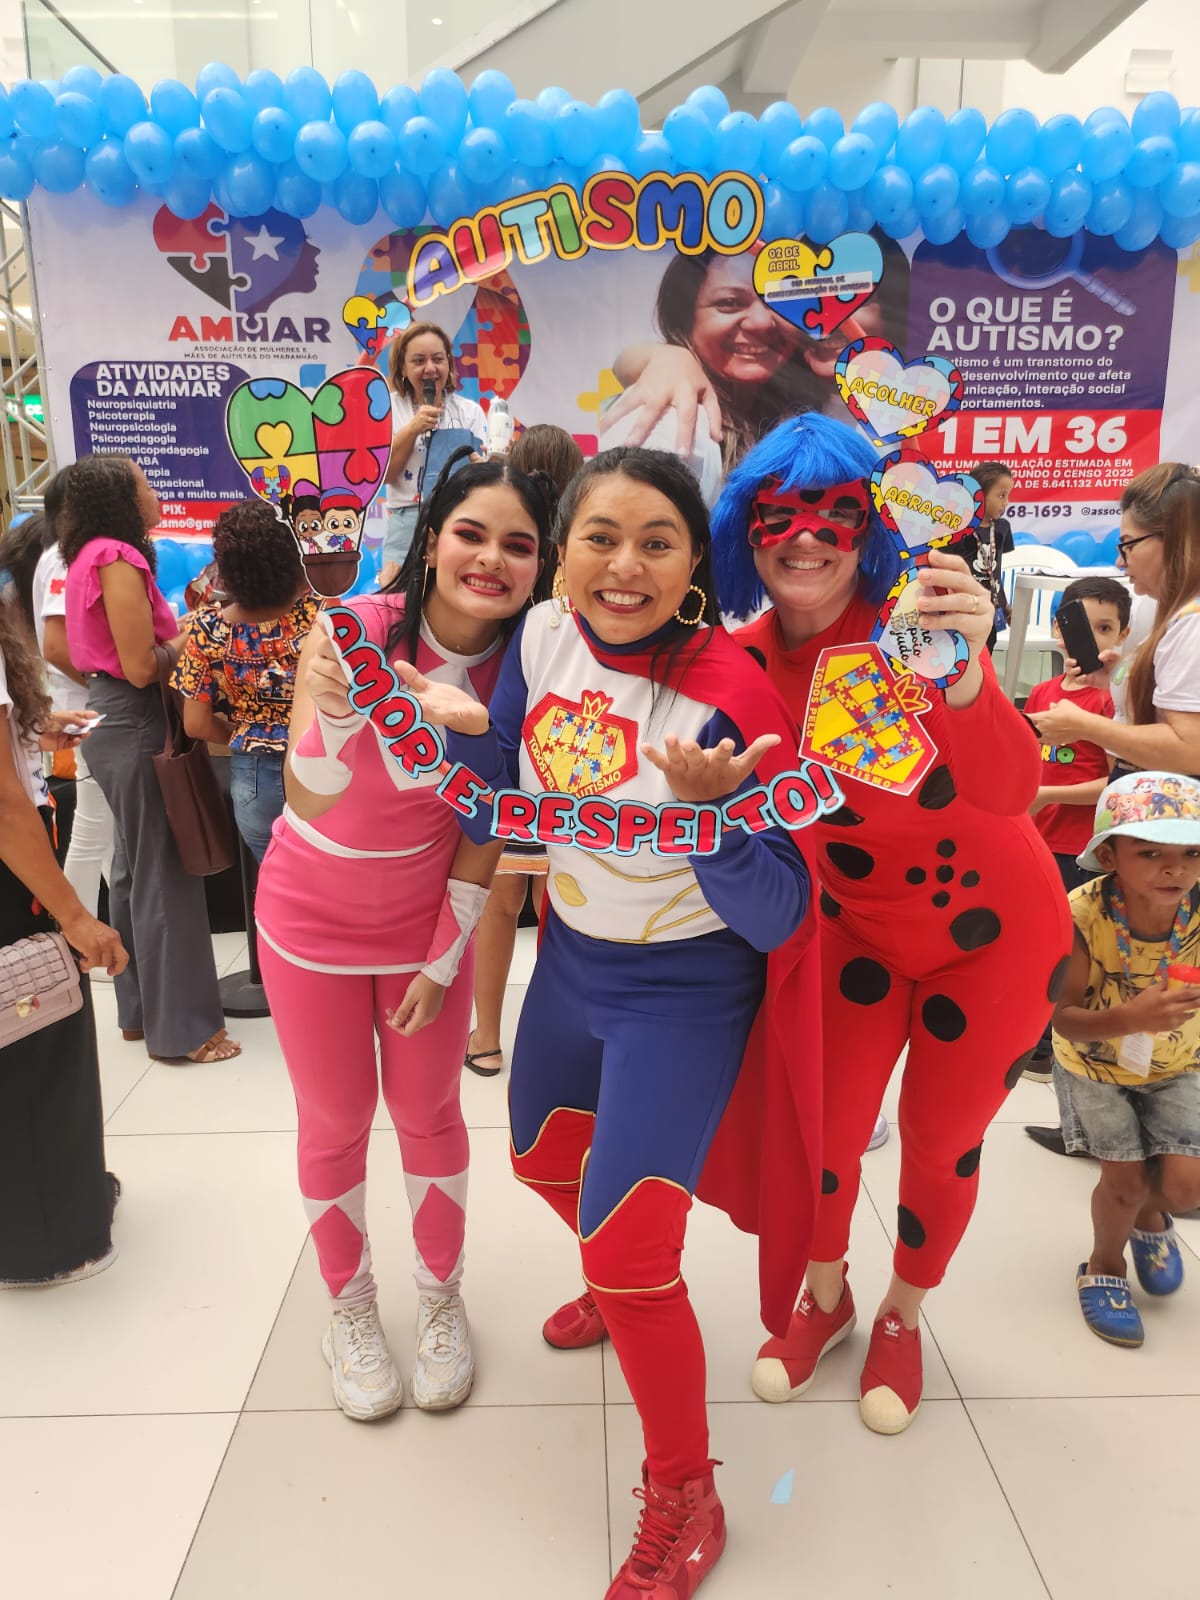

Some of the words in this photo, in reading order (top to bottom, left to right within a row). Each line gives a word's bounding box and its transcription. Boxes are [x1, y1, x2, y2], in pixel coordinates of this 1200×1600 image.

[408, 173, 762, 305] AUTISMO
[768, 247, 782, 258] 02
[784, 246, 799, 257] DE
[768, 260, 800, 272] ABRIL
[929, 297, 956, 323] O
[966, 297, 1043, 325] QUE
[1052, 289, 1073, 323] É
[168, 316, 331, 343] AMMAR
[927, 325, 1124, 351] AUTISMO?
[194, 345, 245, 353] ASSOCIAÇÃO
[951, 357, 989, 367] tismo
[993, 356, 1001, 367] é
[1004, 358, 1023, 367] um
[1027, 356, 1093, 367] transtorno
[1097, 356, 1113, 367] do
[96, 363, 230, 381] ATIVIDADES
[1071, 371, 1095, 382] que
[1098, 369, 1131, 380] afeta
[97, 381, 129, 396] DA
[134, 381, 222, 397] AMMAR
[1025, 383, 1085, 396] interação
[1087, 383, 1126, 394] social
[850, 377, 937, 418] ACOLHER
[87, 400, 177, 410] Neuropsiquiatria
[960, 399, 1045, 410] portamentos.
[88, 411, 155, 422] Psicoterapia
[89, 422, 177, 433] Neuropsicologia
[91, 434, 177, 445] Psicopedagogia
[938, 417, 958, 454] 1
[972, 416, 1053, 454] EM
[1064, 415, 1128, 454] 36
[92, 445, 209, 456] Neuropsicopedagogia
[136, 457, 159, 466] ABA
[955, 459, 980, 469] UMA
[1055, 459, 1112, 468] ESTIMADA
[1114, 458, 1132, 468] EM
[1011, 469, 1050, 478] GUNDO
[1052, 469, 1061, 478] O
[1063, 469, 1102, 478] CENSO
[1105, 468, 1134, 478] 2022
[147, 479, 204, 489] cupacional
[1025, 479, 1039, 488] DE
[1042, 479, 1092, 488] 5.641.132
[178, 491, 185, 499] e
[187, 490, 217, 499] muito
[220, 490, 248, 499] mais.
[162, 504, 186, 515] PIX:
[884, 487, 962, 531] ABRAÇAR
[811, 667, 825, 703] TODOS
[329, 610, 442, 776] AMOR
[440, 766, 490, 815] E
[806, 707, 818, 738] PELO
[528, 736, 547, 772] TODOS
[831, 761, 891, 788] AUTISMO
